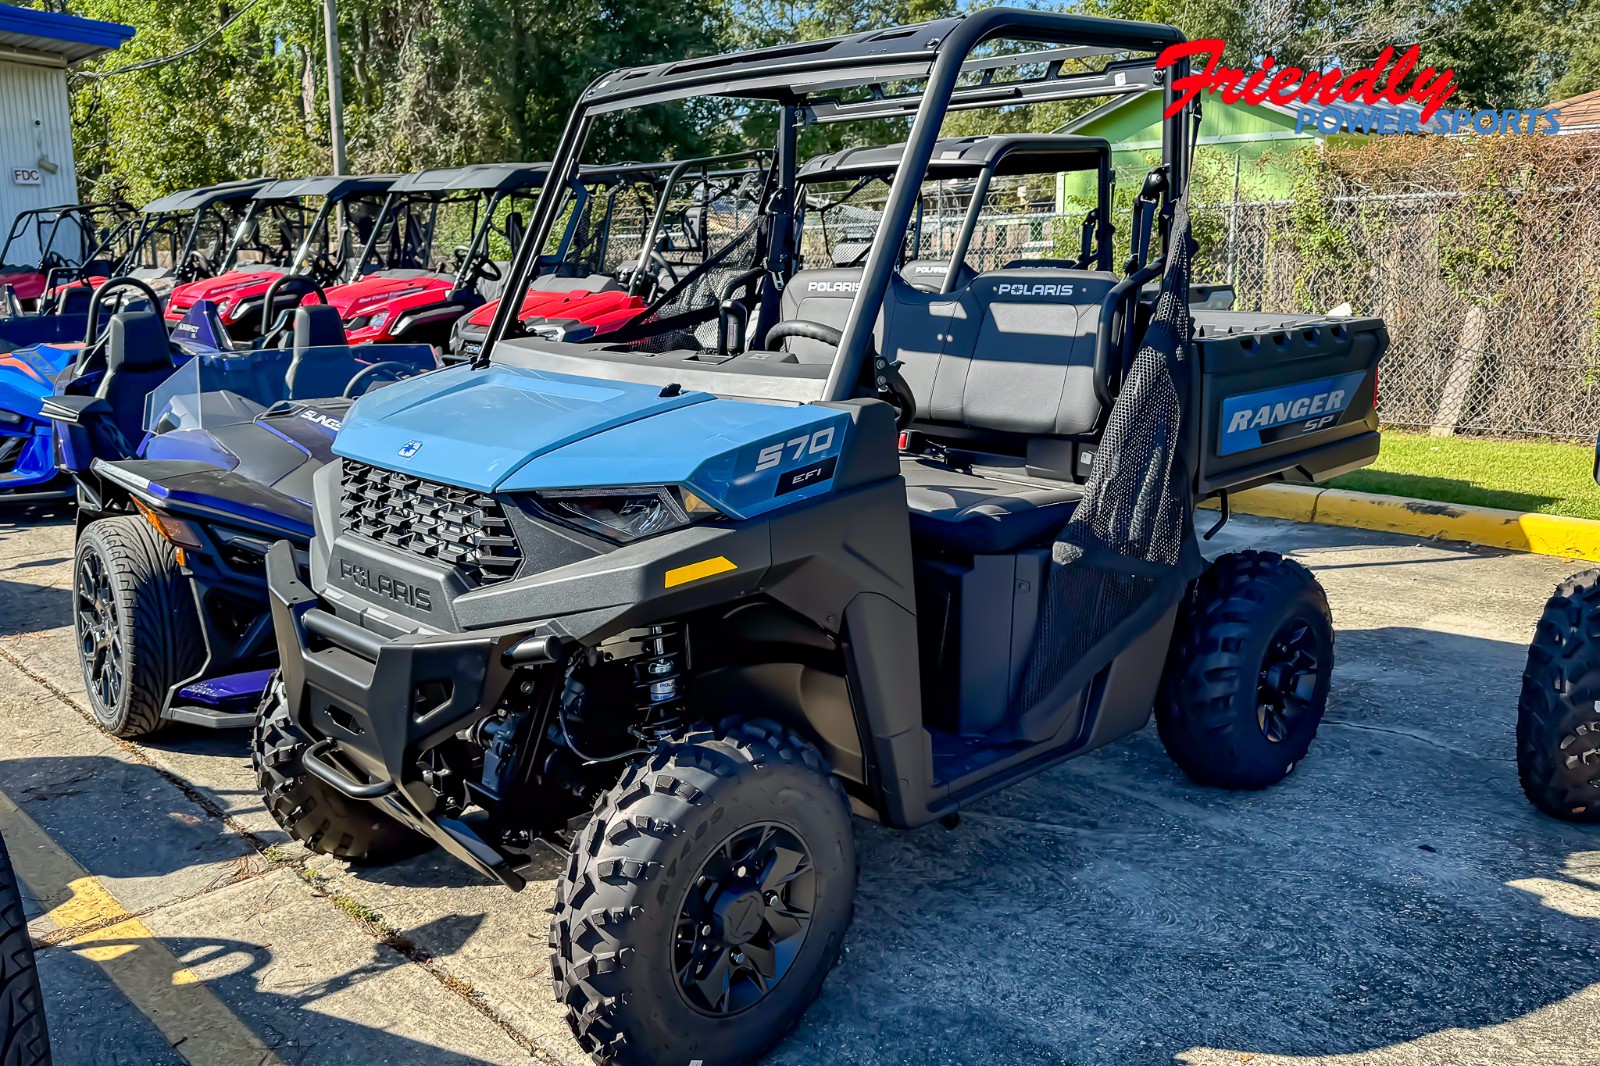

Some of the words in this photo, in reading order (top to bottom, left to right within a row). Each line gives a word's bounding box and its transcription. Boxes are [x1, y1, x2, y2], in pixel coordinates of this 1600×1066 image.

[14, 169, 40, 181] FDC
[998, 283, 1074, 296] POLARIS
[1226, 389, 1345, 434] RANGER
[1302, 414, 1335, 432] SP
[755, 426, 835, 472] 570
[791, 467, 822, 485] EFI
[340, 558, 432, 613] POLARIS
